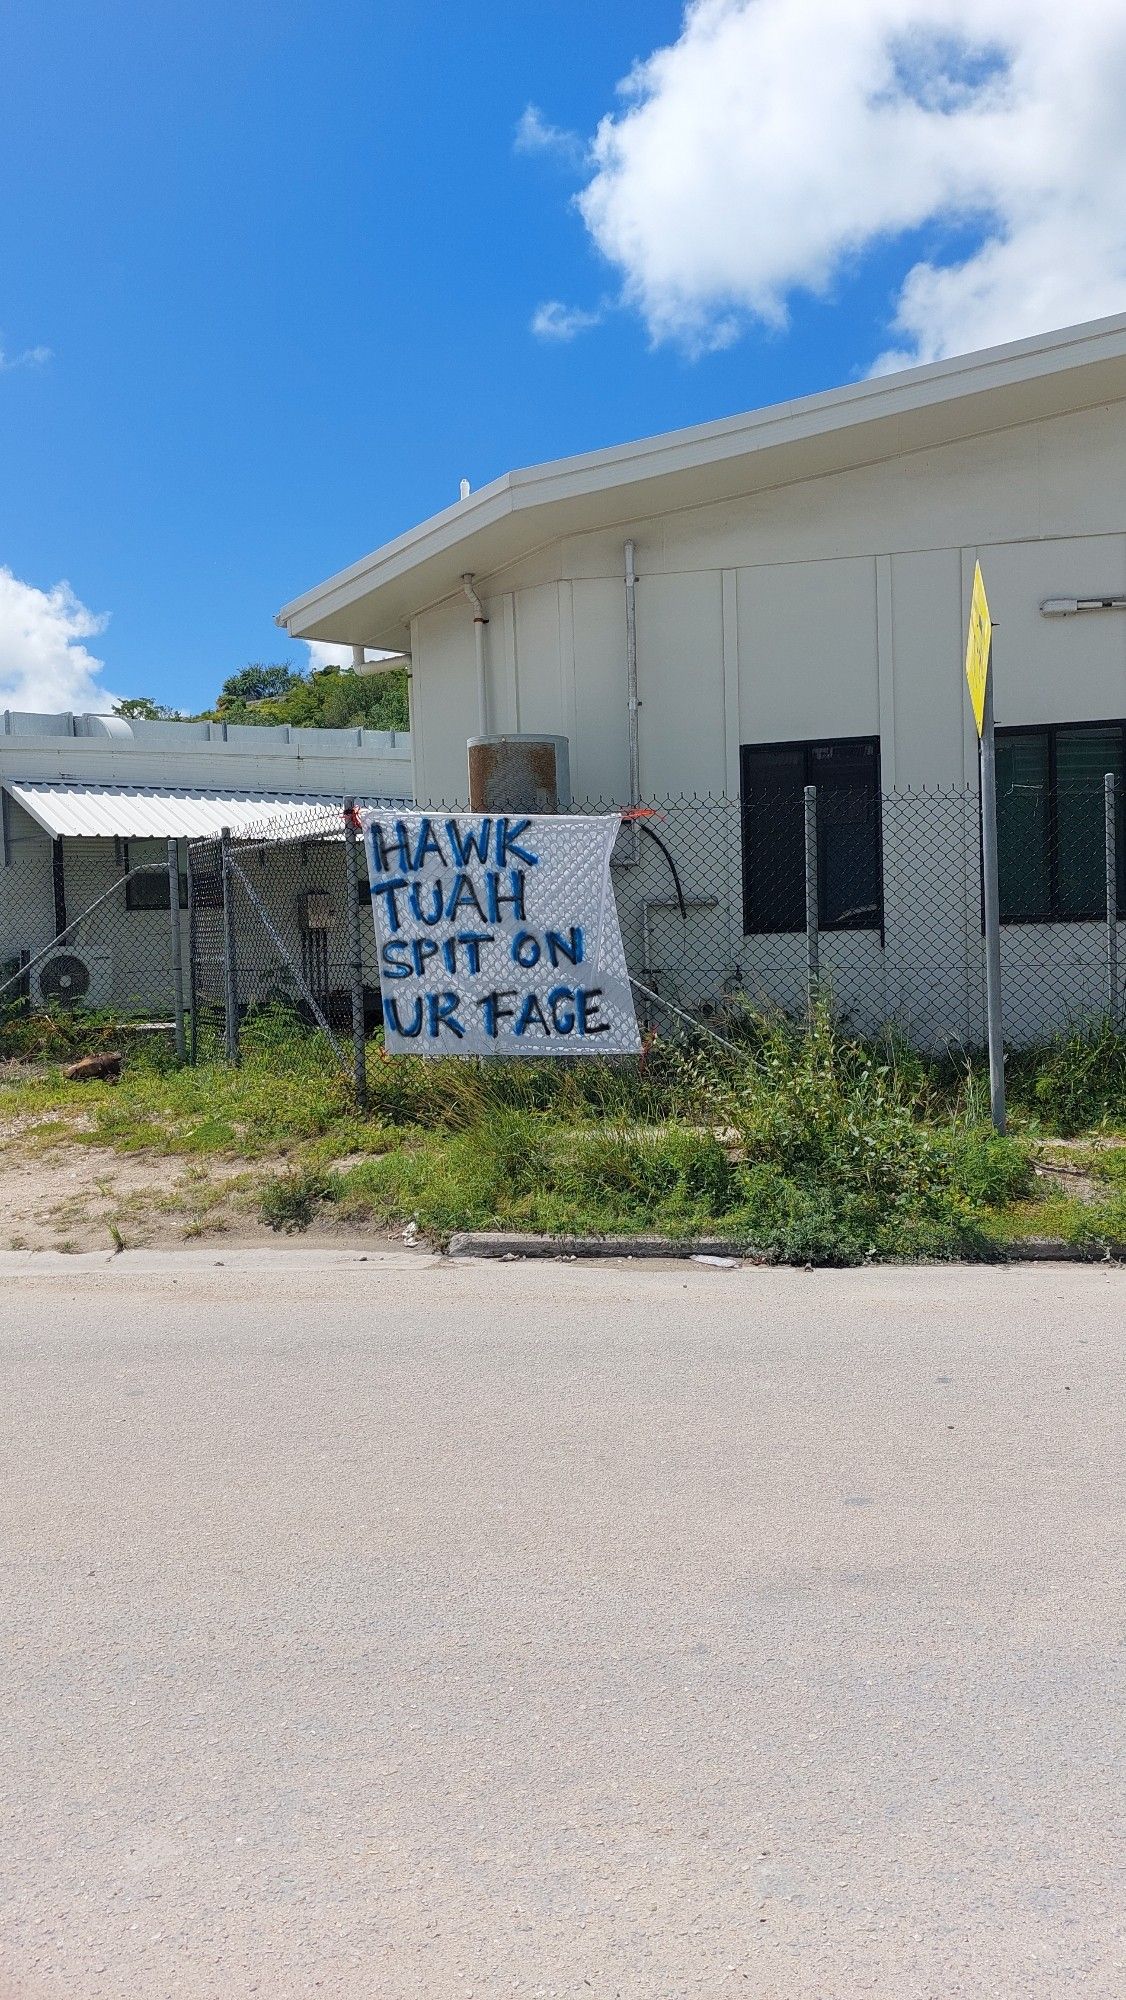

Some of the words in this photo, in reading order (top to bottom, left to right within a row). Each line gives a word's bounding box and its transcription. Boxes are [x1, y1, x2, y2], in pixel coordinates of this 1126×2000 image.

[370, 818, 539, 873] HAWK
[370, 870, 526, 932] TUAH
[381, 930, 495, 979] SPIT
[511, 927, 584, 968] ON
[384, 990, 466, 1038] UR
